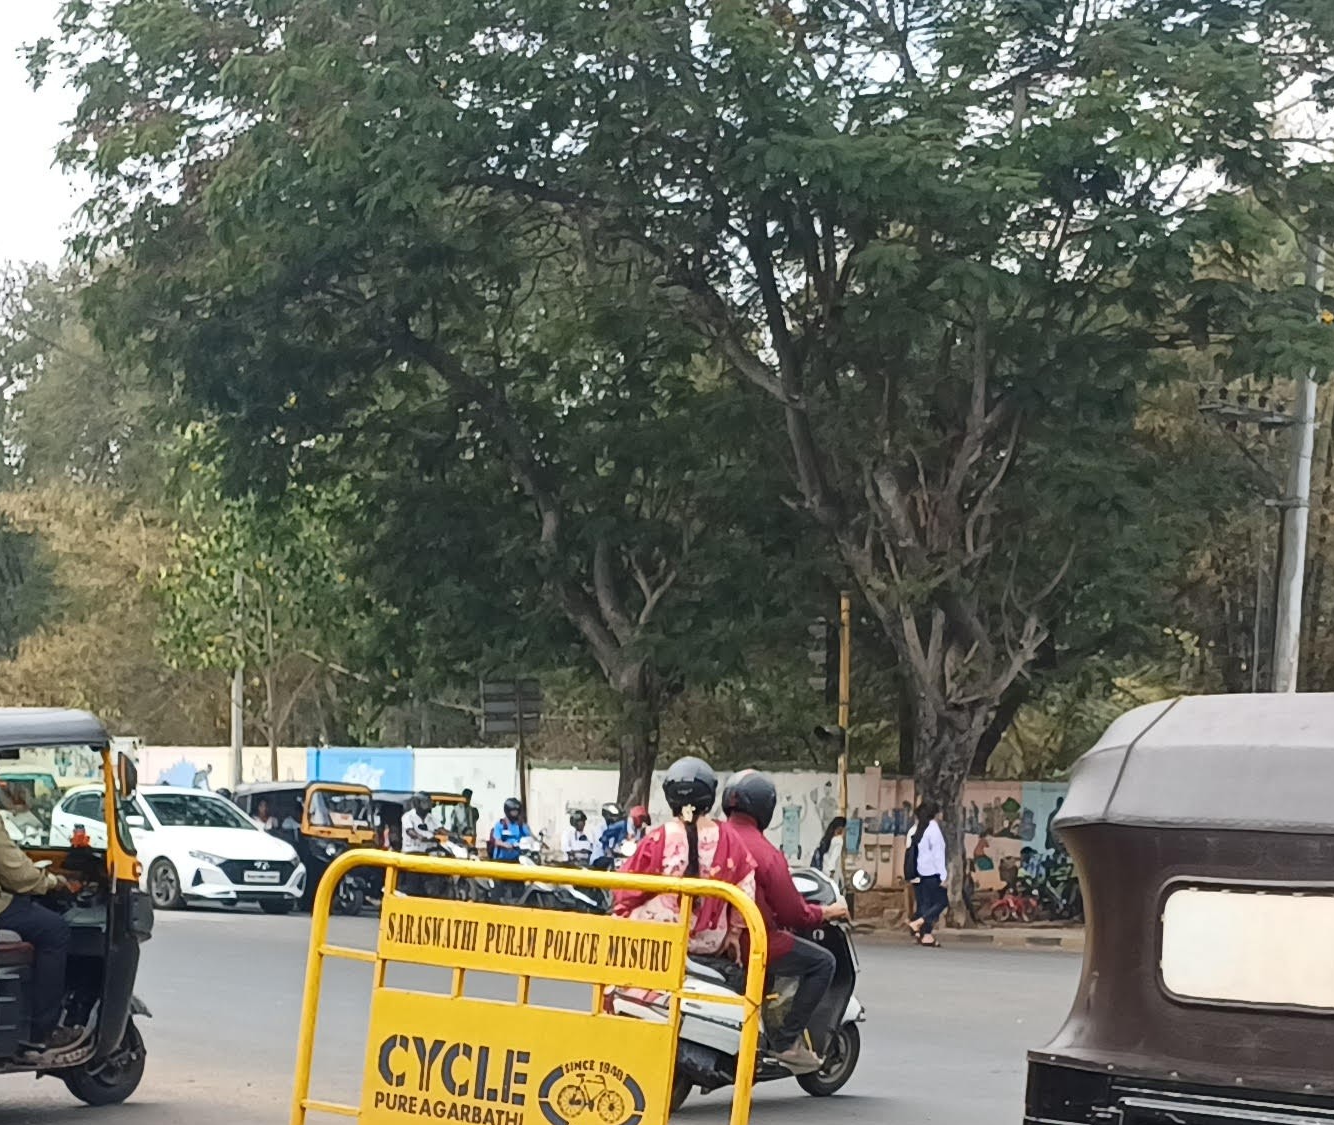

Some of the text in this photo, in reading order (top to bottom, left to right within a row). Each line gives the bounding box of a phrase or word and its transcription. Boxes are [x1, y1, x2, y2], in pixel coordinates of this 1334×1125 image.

[387, 912, 673, 973] SARASWATHI PURAM POLICE MYSURU
[378, 1034, 530, 1106] CYCLE
[564, 1060, 595, 1074] SINCE
